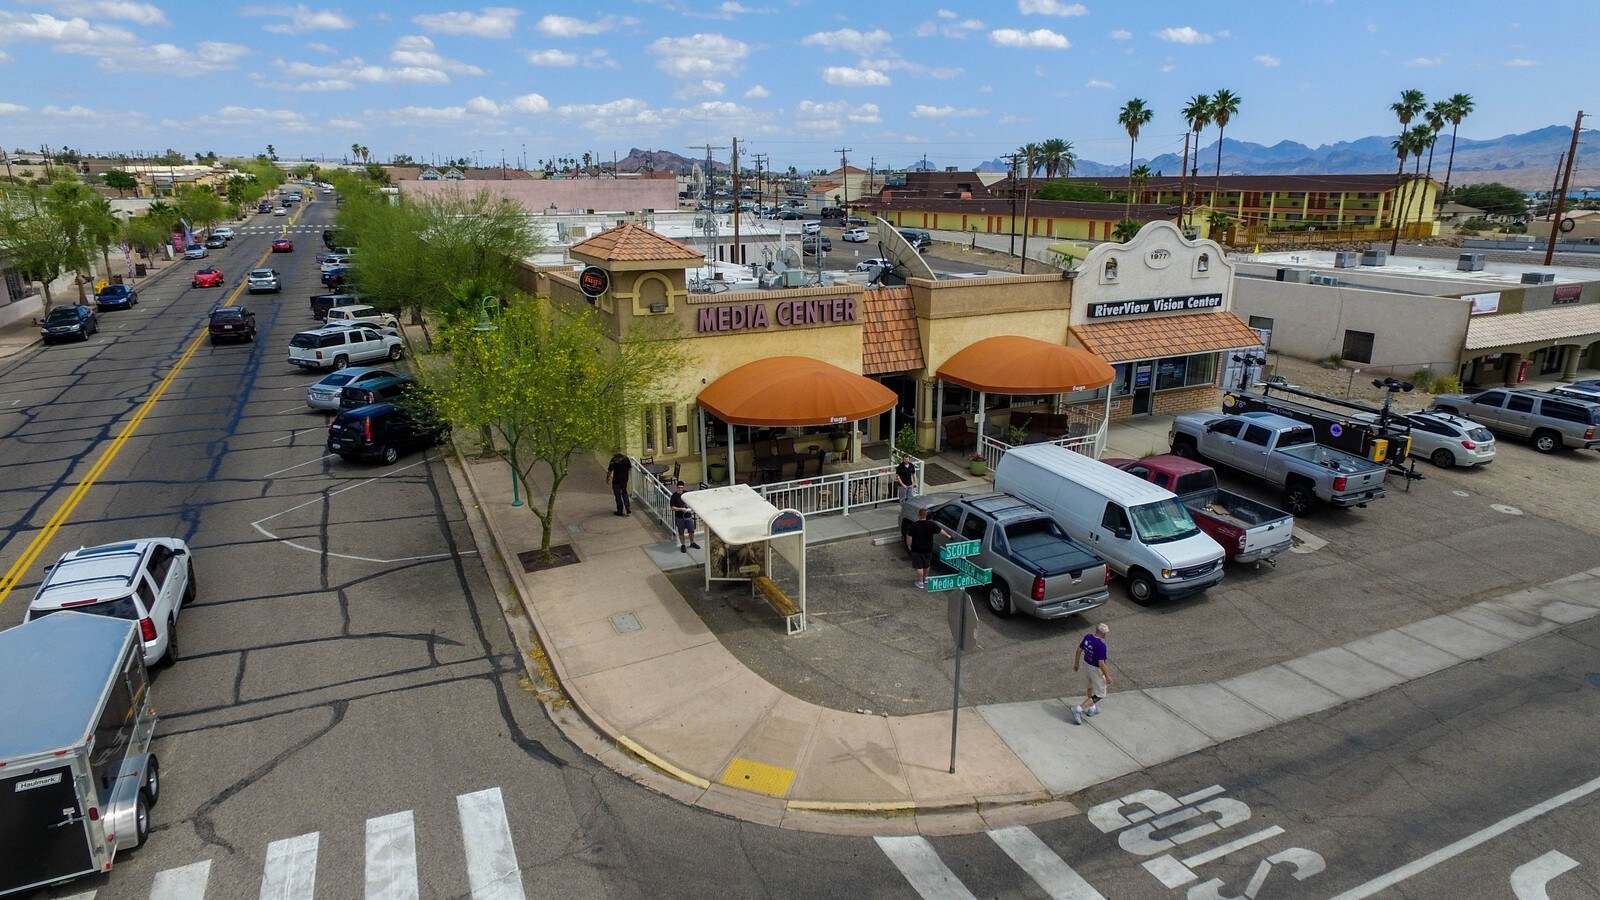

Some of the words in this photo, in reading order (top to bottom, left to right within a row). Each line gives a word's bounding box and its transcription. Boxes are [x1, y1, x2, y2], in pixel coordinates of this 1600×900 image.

[584, 275, 603, 287] fugs
[1095, 302, 1149, 317] RiverView
[1153, 298, 1184, 312] Vision
[1187, 296, 1220, 309] Center
[698, 304, 769, 332] MEDIA
[776, 298, 858, 326] CENTER
[830, 416, 847, 424] fugs
[946, 543, 971, 558] SCOTT
[945, 557, 976, 578] CULLOCH
[932, 578, 954, 589] Media
[956, 575, 979, 587] Cente
[20, 777, 55, 789] Haulmark
